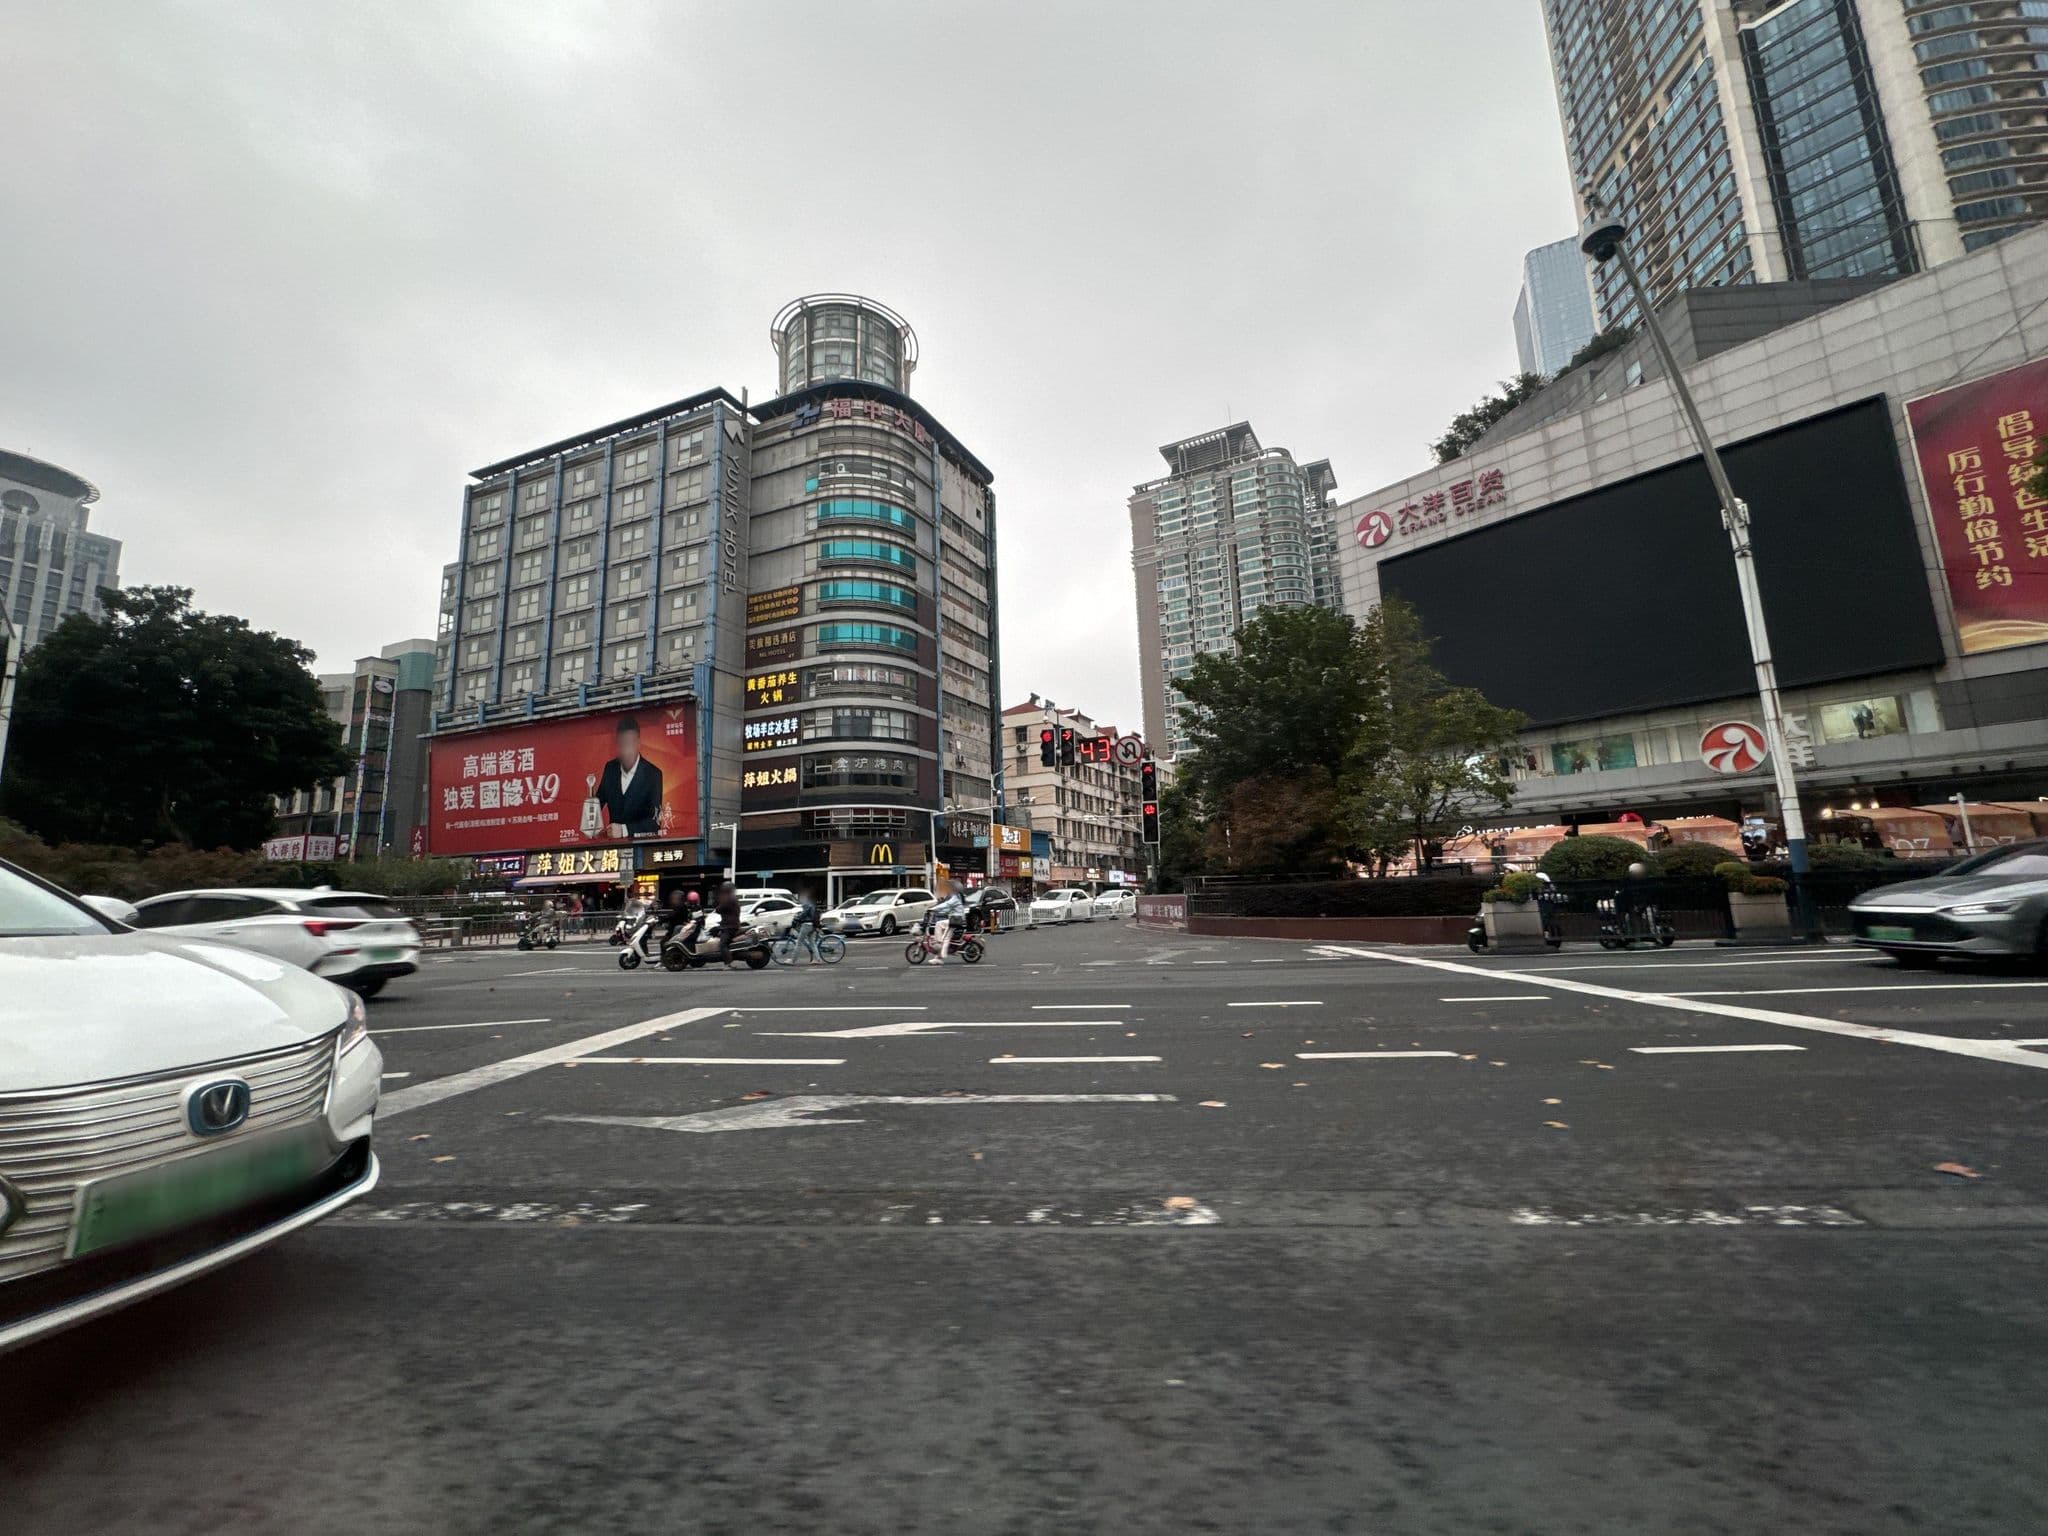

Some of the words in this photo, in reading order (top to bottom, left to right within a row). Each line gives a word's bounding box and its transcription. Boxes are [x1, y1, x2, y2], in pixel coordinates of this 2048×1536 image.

[726, 453, 740, 524] YUNIK
[1398, 468, 1505, 525] 大洋百货
[1400, 512, 1447, 537] GRAND
[1454, 492, 1507, 517] OCEAN
[1947, 446, 2013, 590] 厉行勤俭节约
[723, 527, 738, 595] HOTEL
[760, 689, 783, 705] 火锅
[463, 747, 535, 779] 高端酱酒
[1080, 738, 1111, 763] 43
[653, 850, 684, 862] 麦当劳
